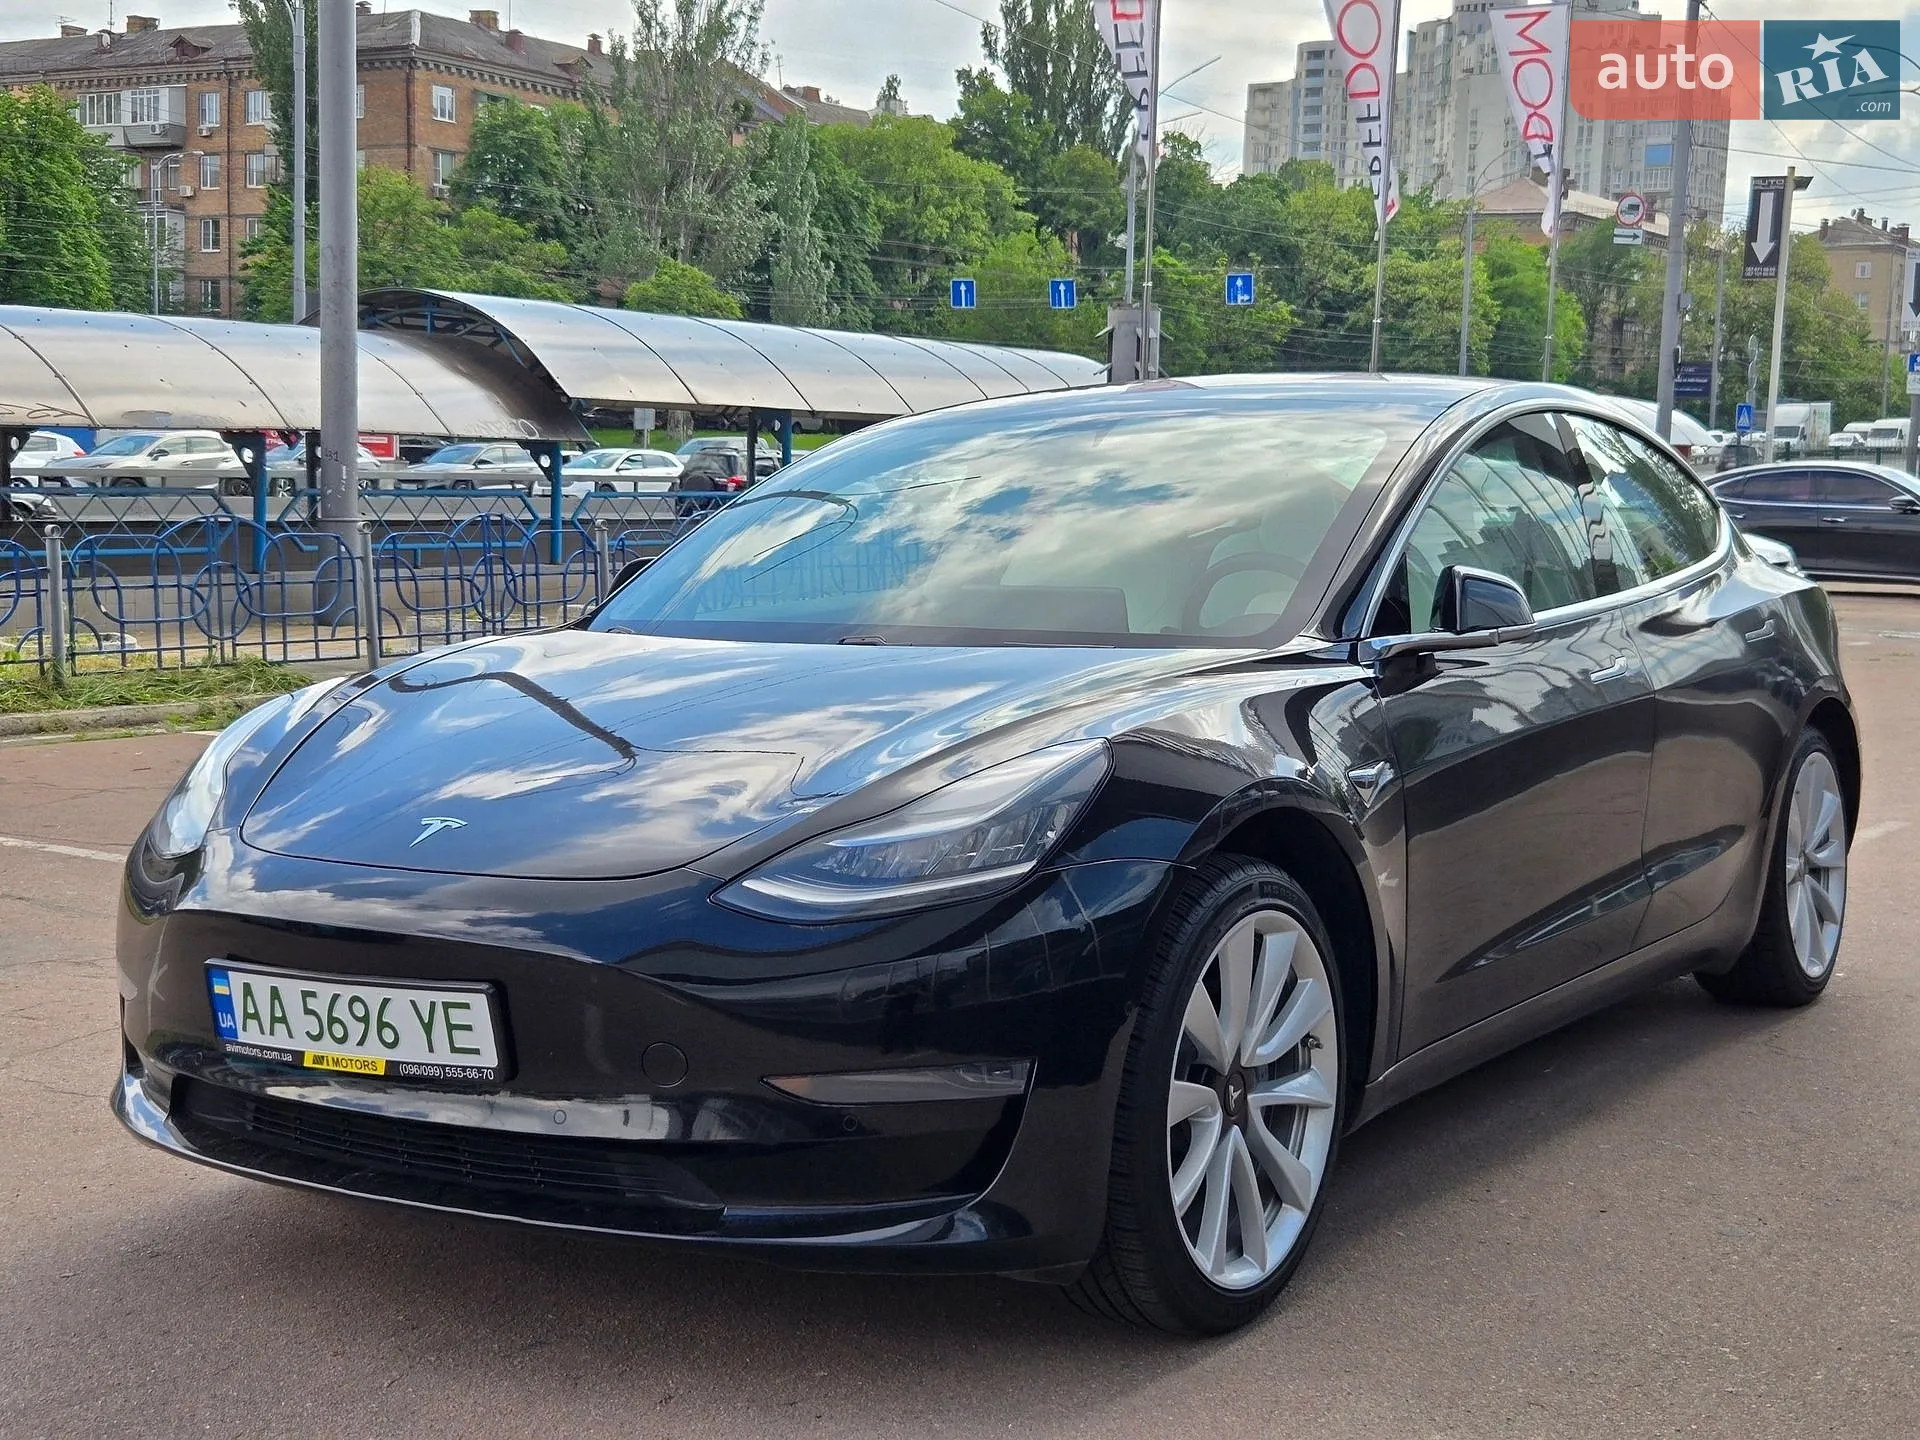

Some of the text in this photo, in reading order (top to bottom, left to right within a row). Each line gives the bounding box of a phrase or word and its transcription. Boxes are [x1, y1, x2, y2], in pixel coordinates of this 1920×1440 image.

[218, 1012, 235, 1029] UA
[241, 981, 480, 1055] AA 5696 YE
[225, 1043, 293, 1061] avimotors.com.ua
[332, 1058, 378, 1072] MOTORS
[399, 1064, 494, 1080] (096/099) 555-66-70
